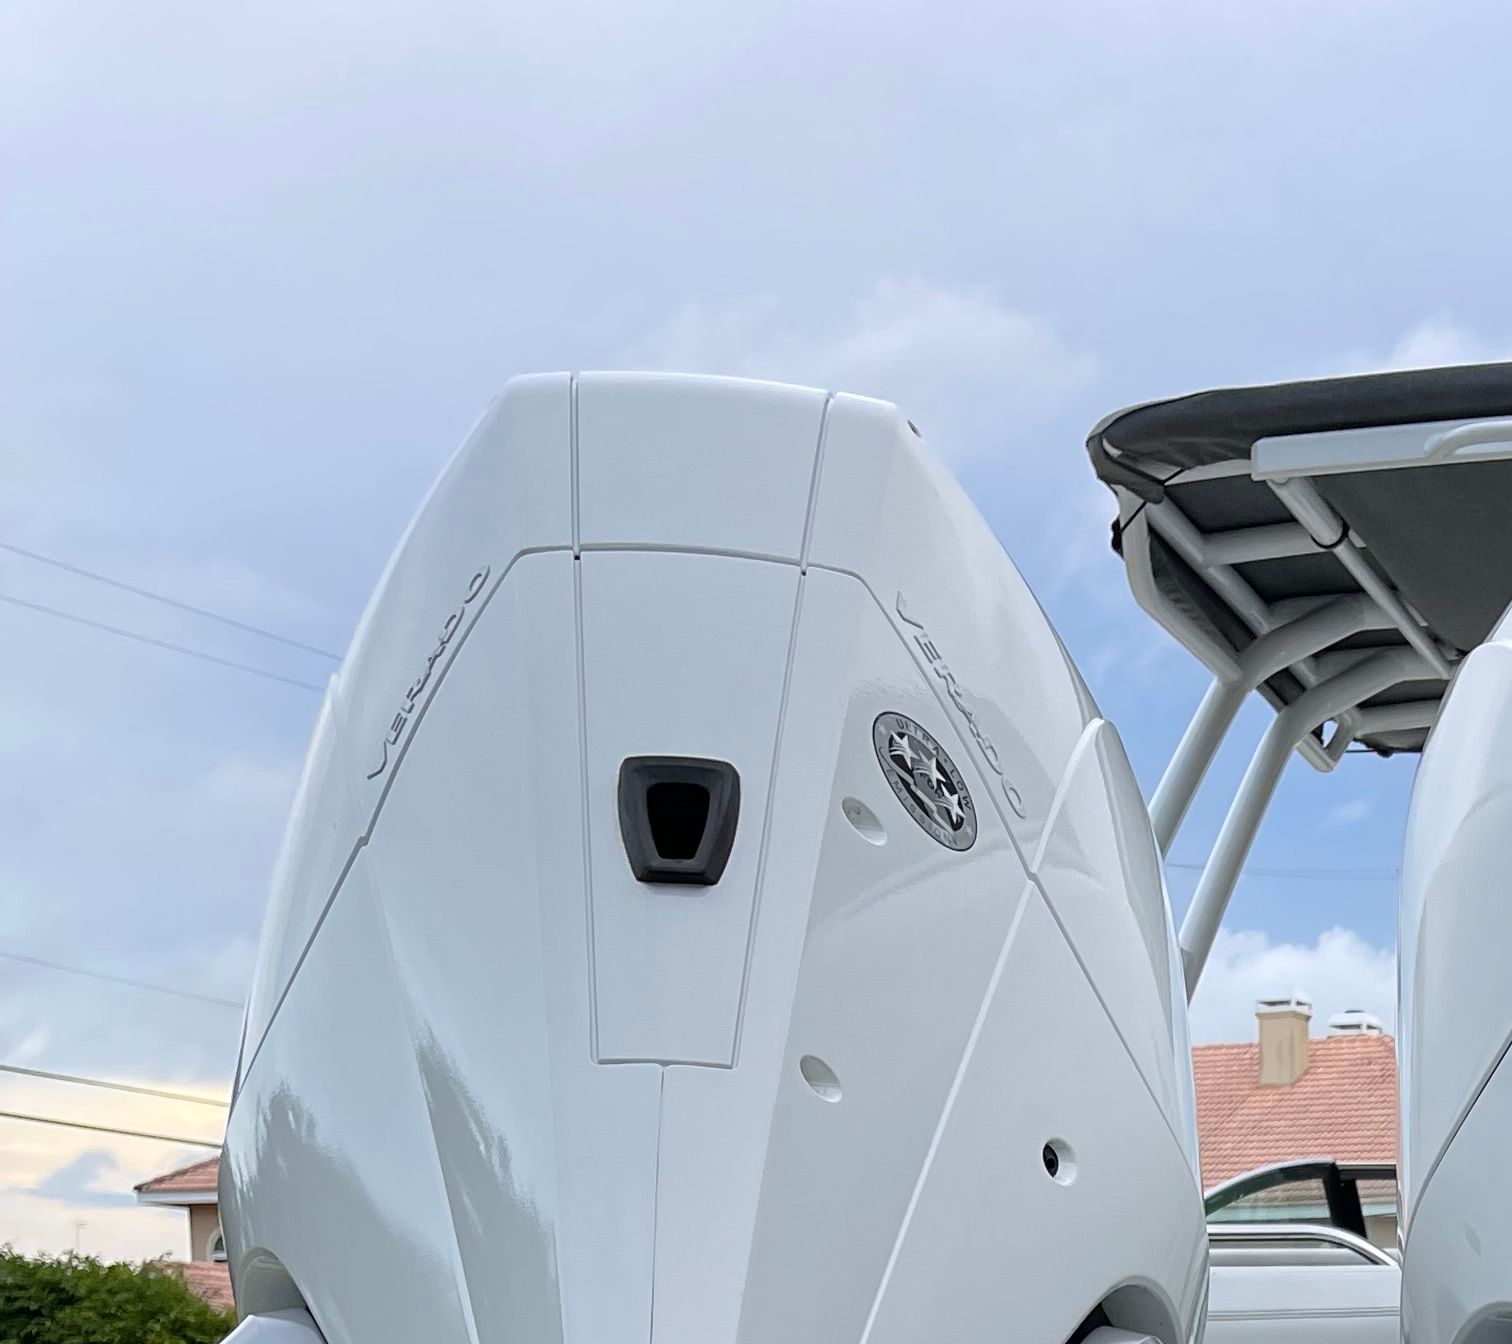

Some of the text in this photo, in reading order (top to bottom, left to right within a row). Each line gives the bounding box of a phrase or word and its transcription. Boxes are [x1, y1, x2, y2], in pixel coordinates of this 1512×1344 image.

[366, 563, 491, 780] VERADO
[895, 589, 1027, 820] VERADO
[895, 718, 940, 757] ULTRA
[948, 767, 972, 811] LOW
